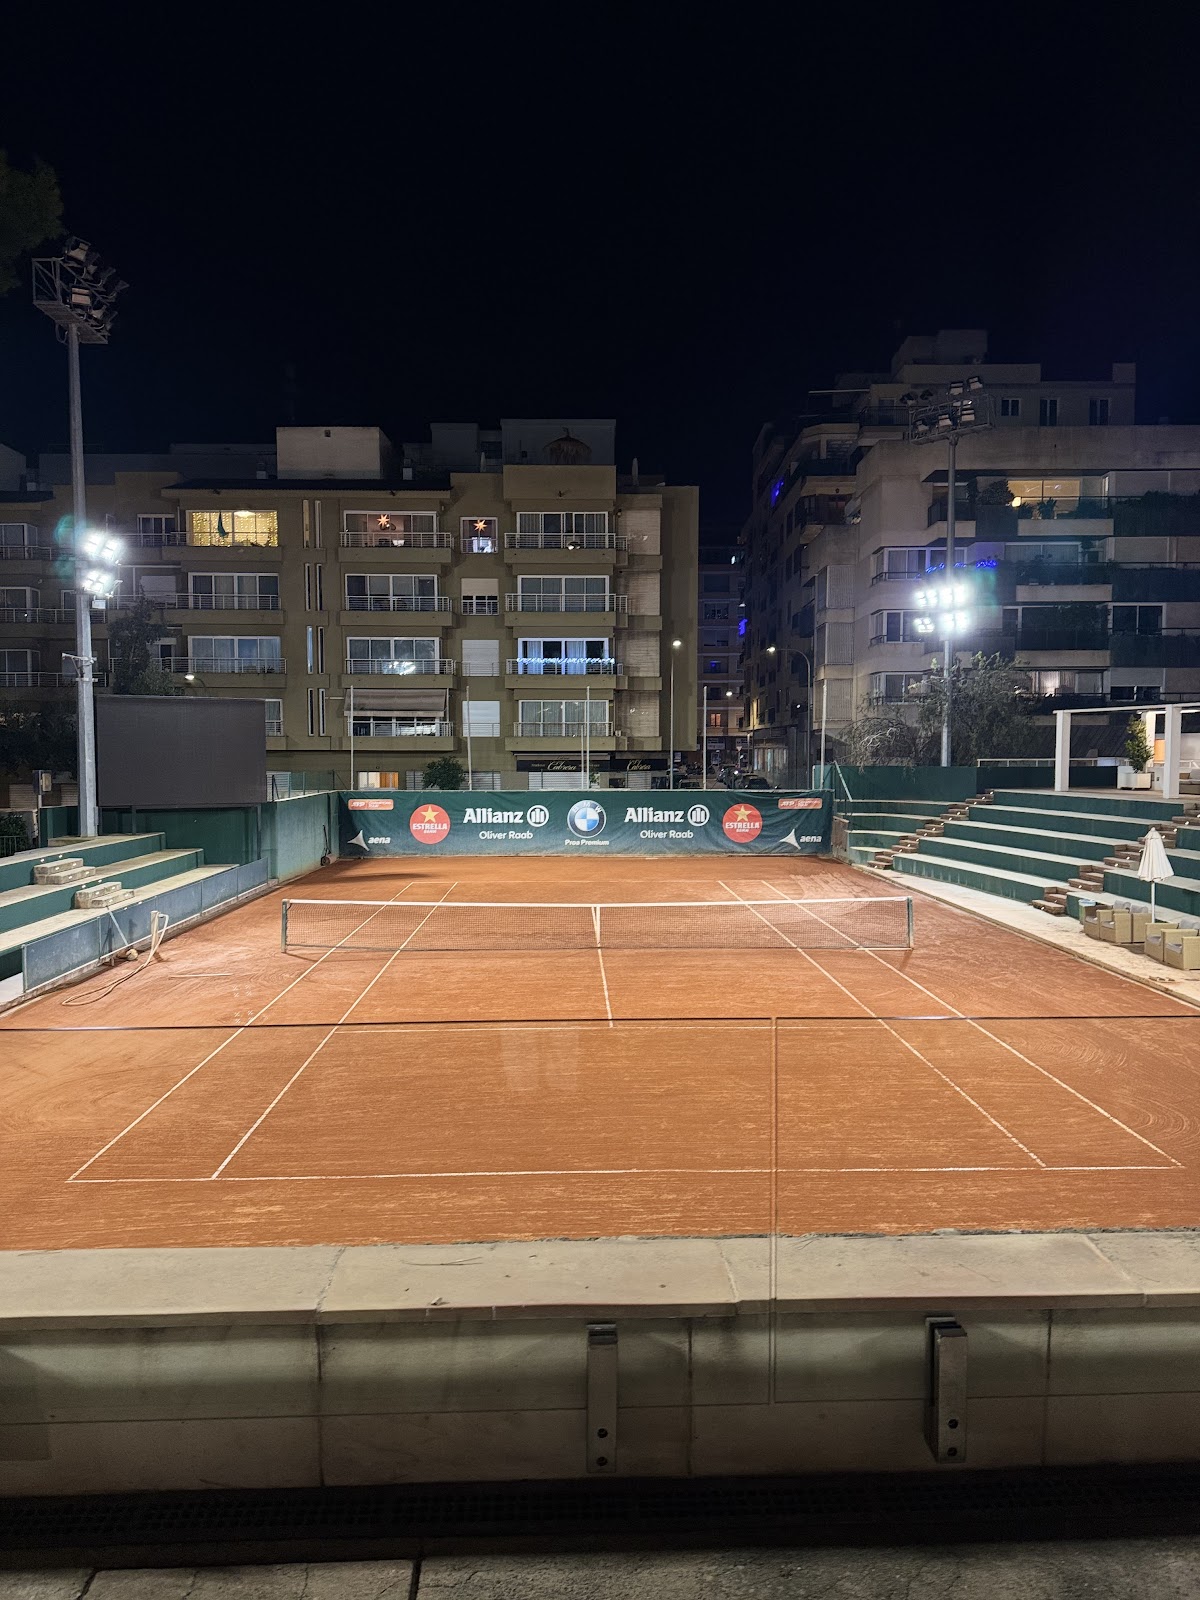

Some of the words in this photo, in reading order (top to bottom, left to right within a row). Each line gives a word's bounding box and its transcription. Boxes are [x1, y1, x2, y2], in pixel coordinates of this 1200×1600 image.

[463, 808, 524, 824] Allianz
[624, 807, 684, 823] Allianz
[479, 831, 507, 840] Oliver
[508, 831, 534, 840] Raab
[640, 830, 667, 839] Oliver
[669, 830, 694, 839] Raab
[800, 835, 822, 843] aena
